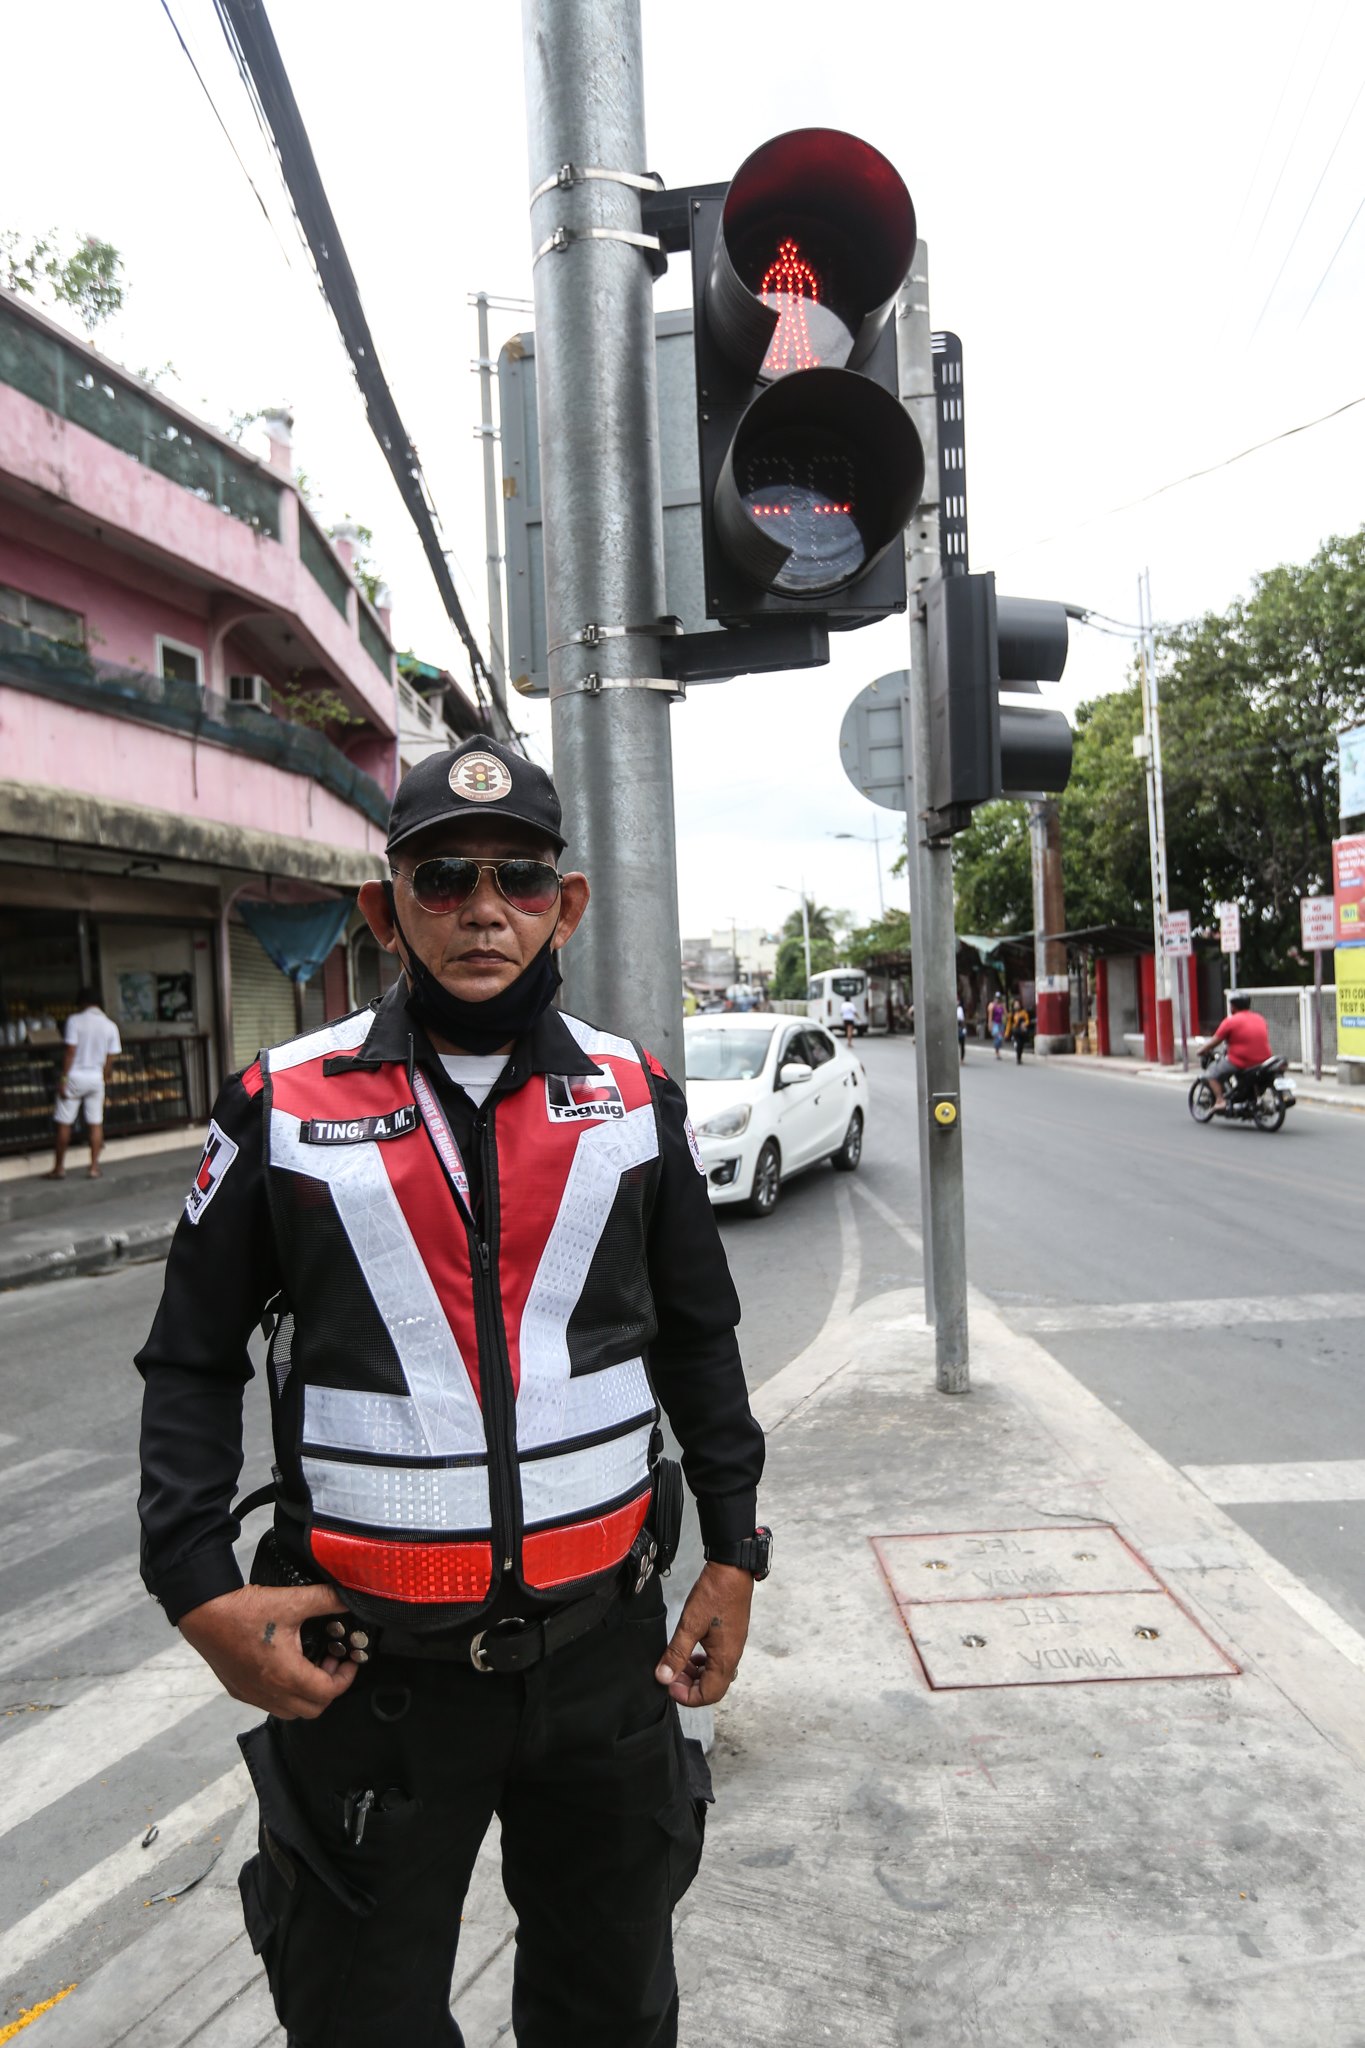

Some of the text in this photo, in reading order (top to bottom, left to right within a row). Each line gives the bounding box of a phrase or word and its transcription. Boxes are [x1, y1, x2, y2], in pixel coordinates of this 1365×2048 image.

[463, 754, 497, 764] MANAGEMENT
[550, 1102, 624, 1119] Taguig
[315, 1109, 410, 1139] TING, A. M.
[429, 1117, 444, 1132] OF
[435, 1131, 459, 1169] TAGUIG
[972, 1566, 1070, 1590] MMDA
[1009, 1606, 1078, 1628] TEC
[1017, 1647, 1125, 1671] MMDA
